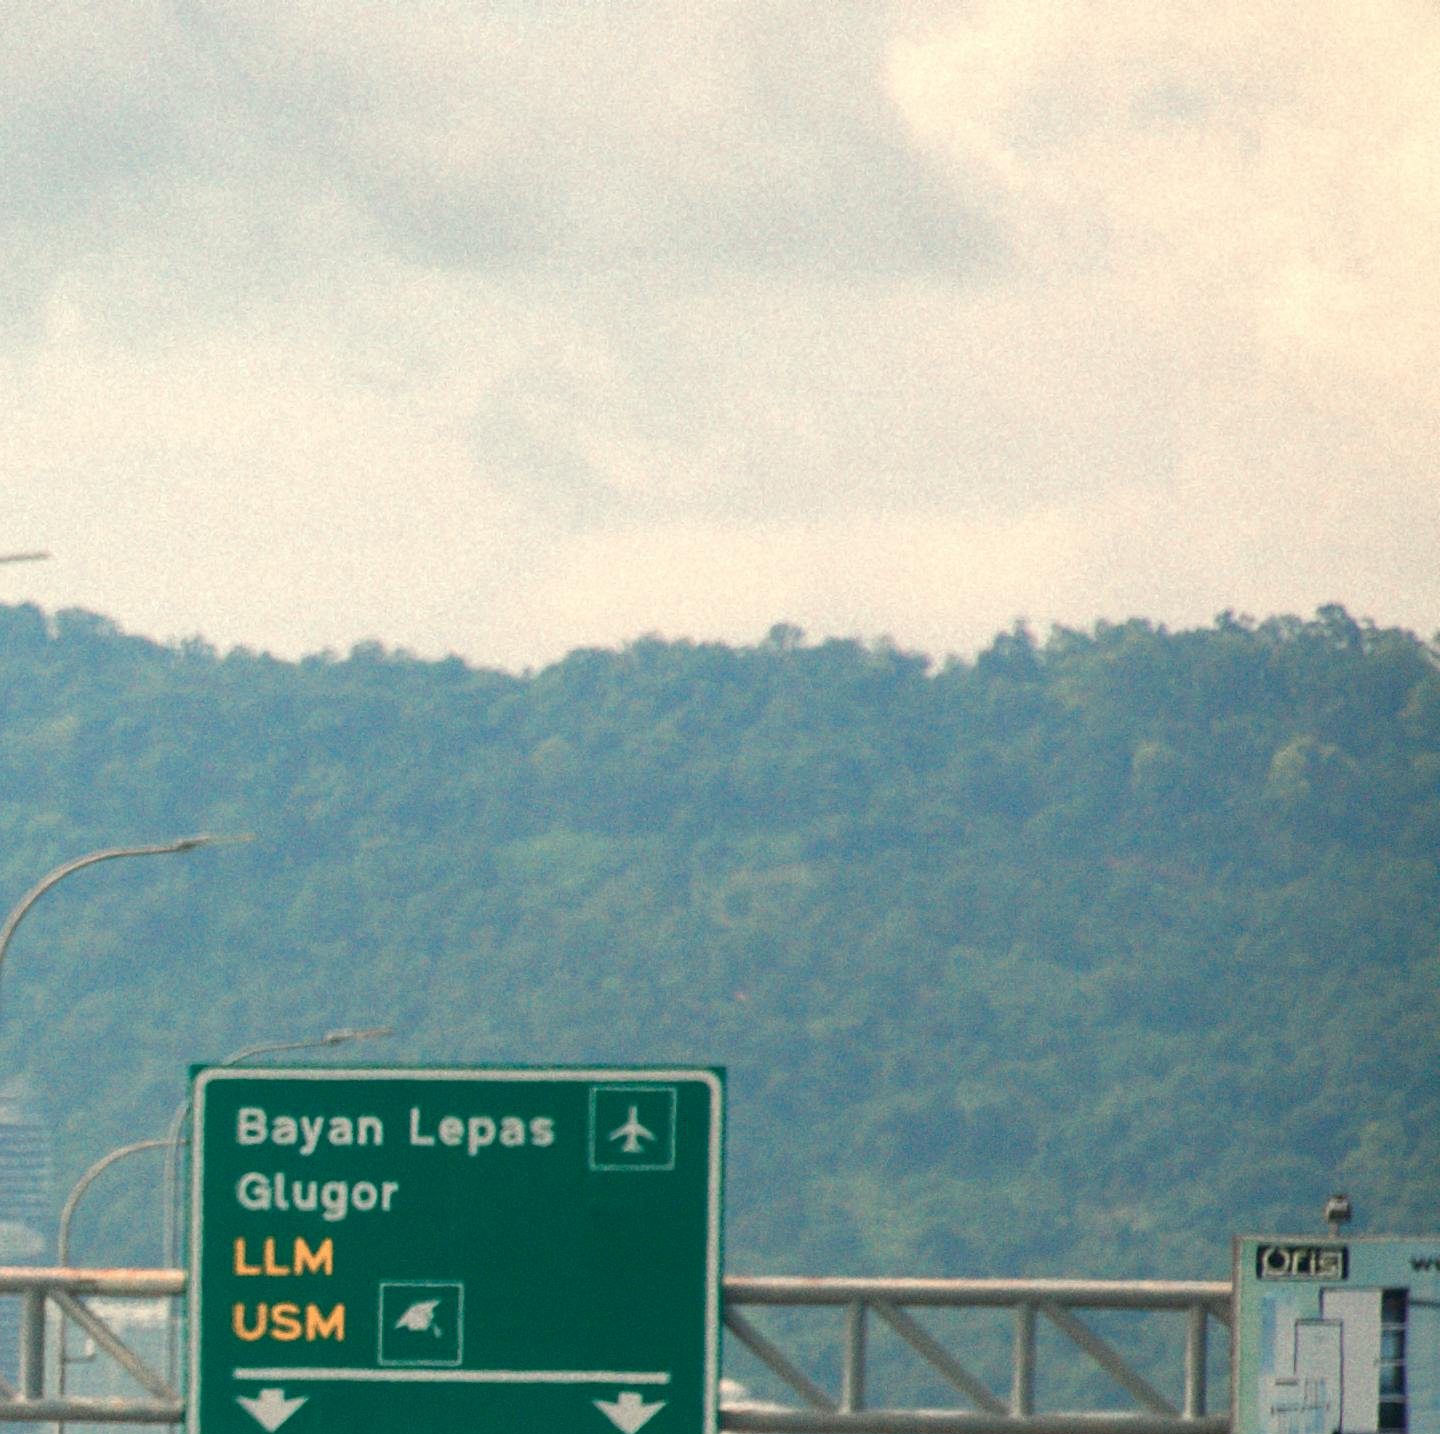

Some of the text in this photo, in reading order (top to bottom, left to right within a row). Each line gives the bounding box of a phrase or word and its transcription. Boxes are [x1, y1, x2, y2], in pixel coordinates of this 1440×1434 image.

[235, 1106, 556, 1157] Bayan Lepas
[235, 1172, 399, 1222] Glugor
[233, 1236, 334, 1277] LLM
[232, 1302, 346, 1342] USM
